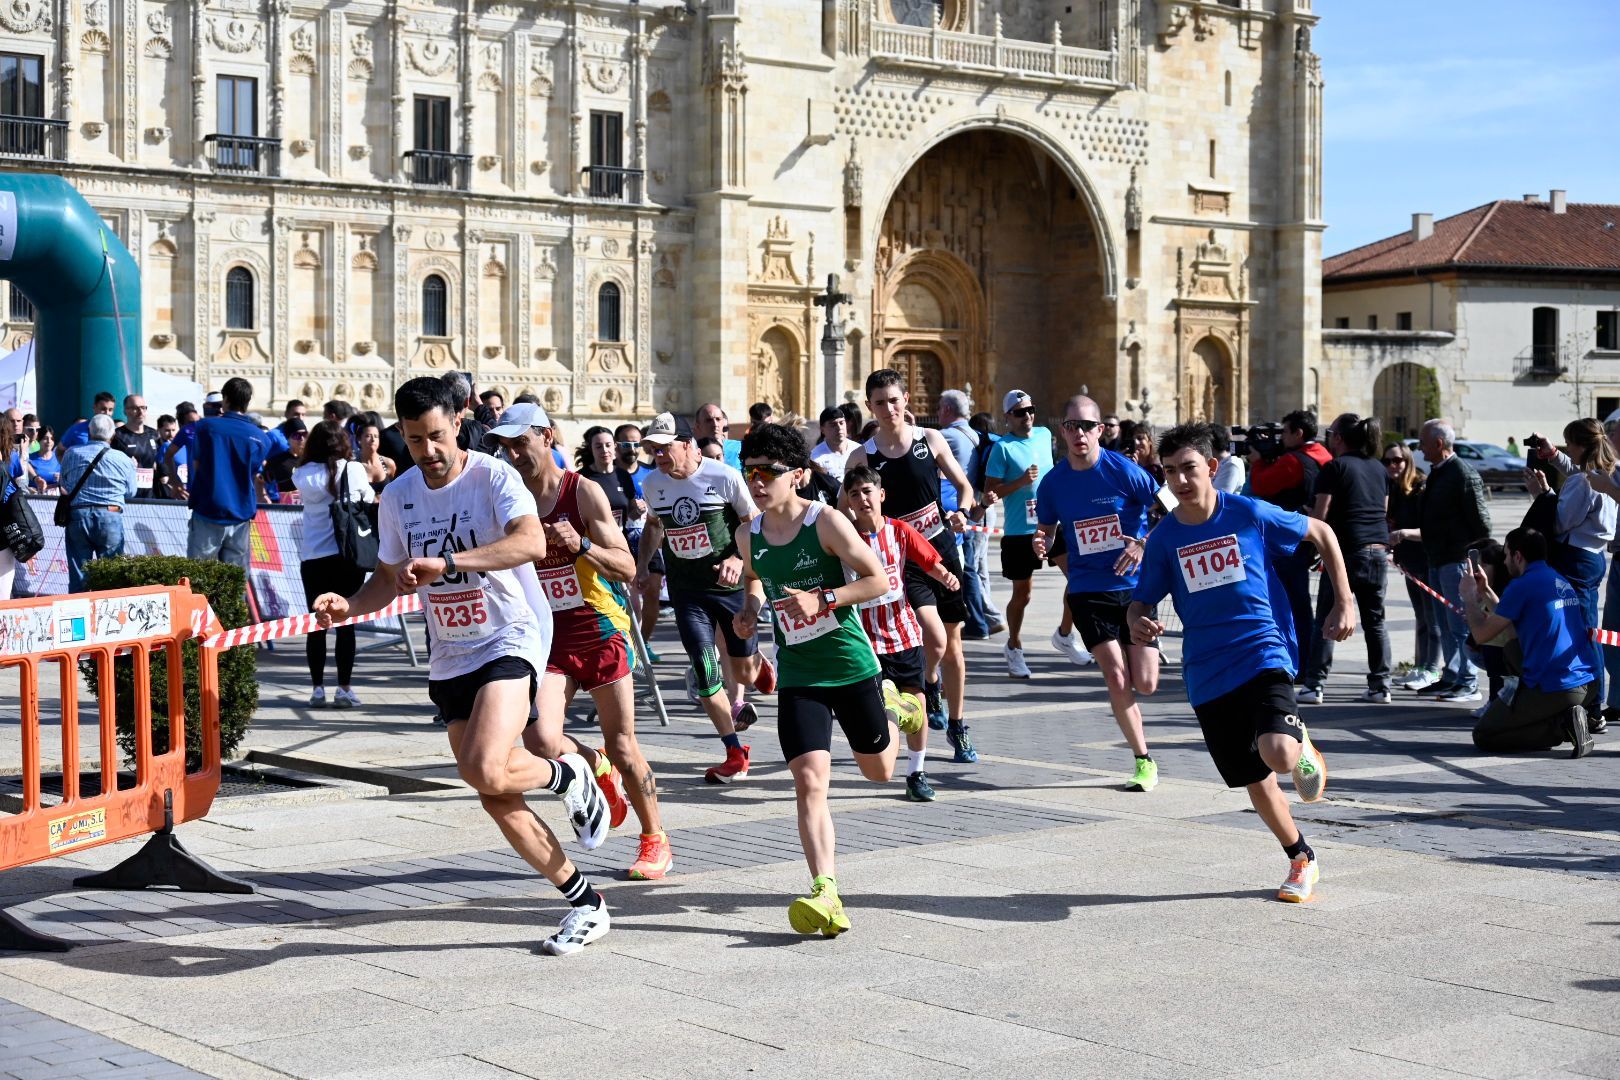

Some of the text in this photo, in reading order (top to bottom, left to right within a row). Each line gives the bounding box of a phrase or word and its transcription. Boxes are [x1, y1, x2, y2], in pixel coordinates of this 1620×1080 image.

[671, 533, 709, 551] 1272
[1079, 524, 1121, 545] 1274
[1195, 543, 1217, 552] CASTILLA
[1184, 548, 1239, 579] 1104
[434, 602, 487, 628] 1235
